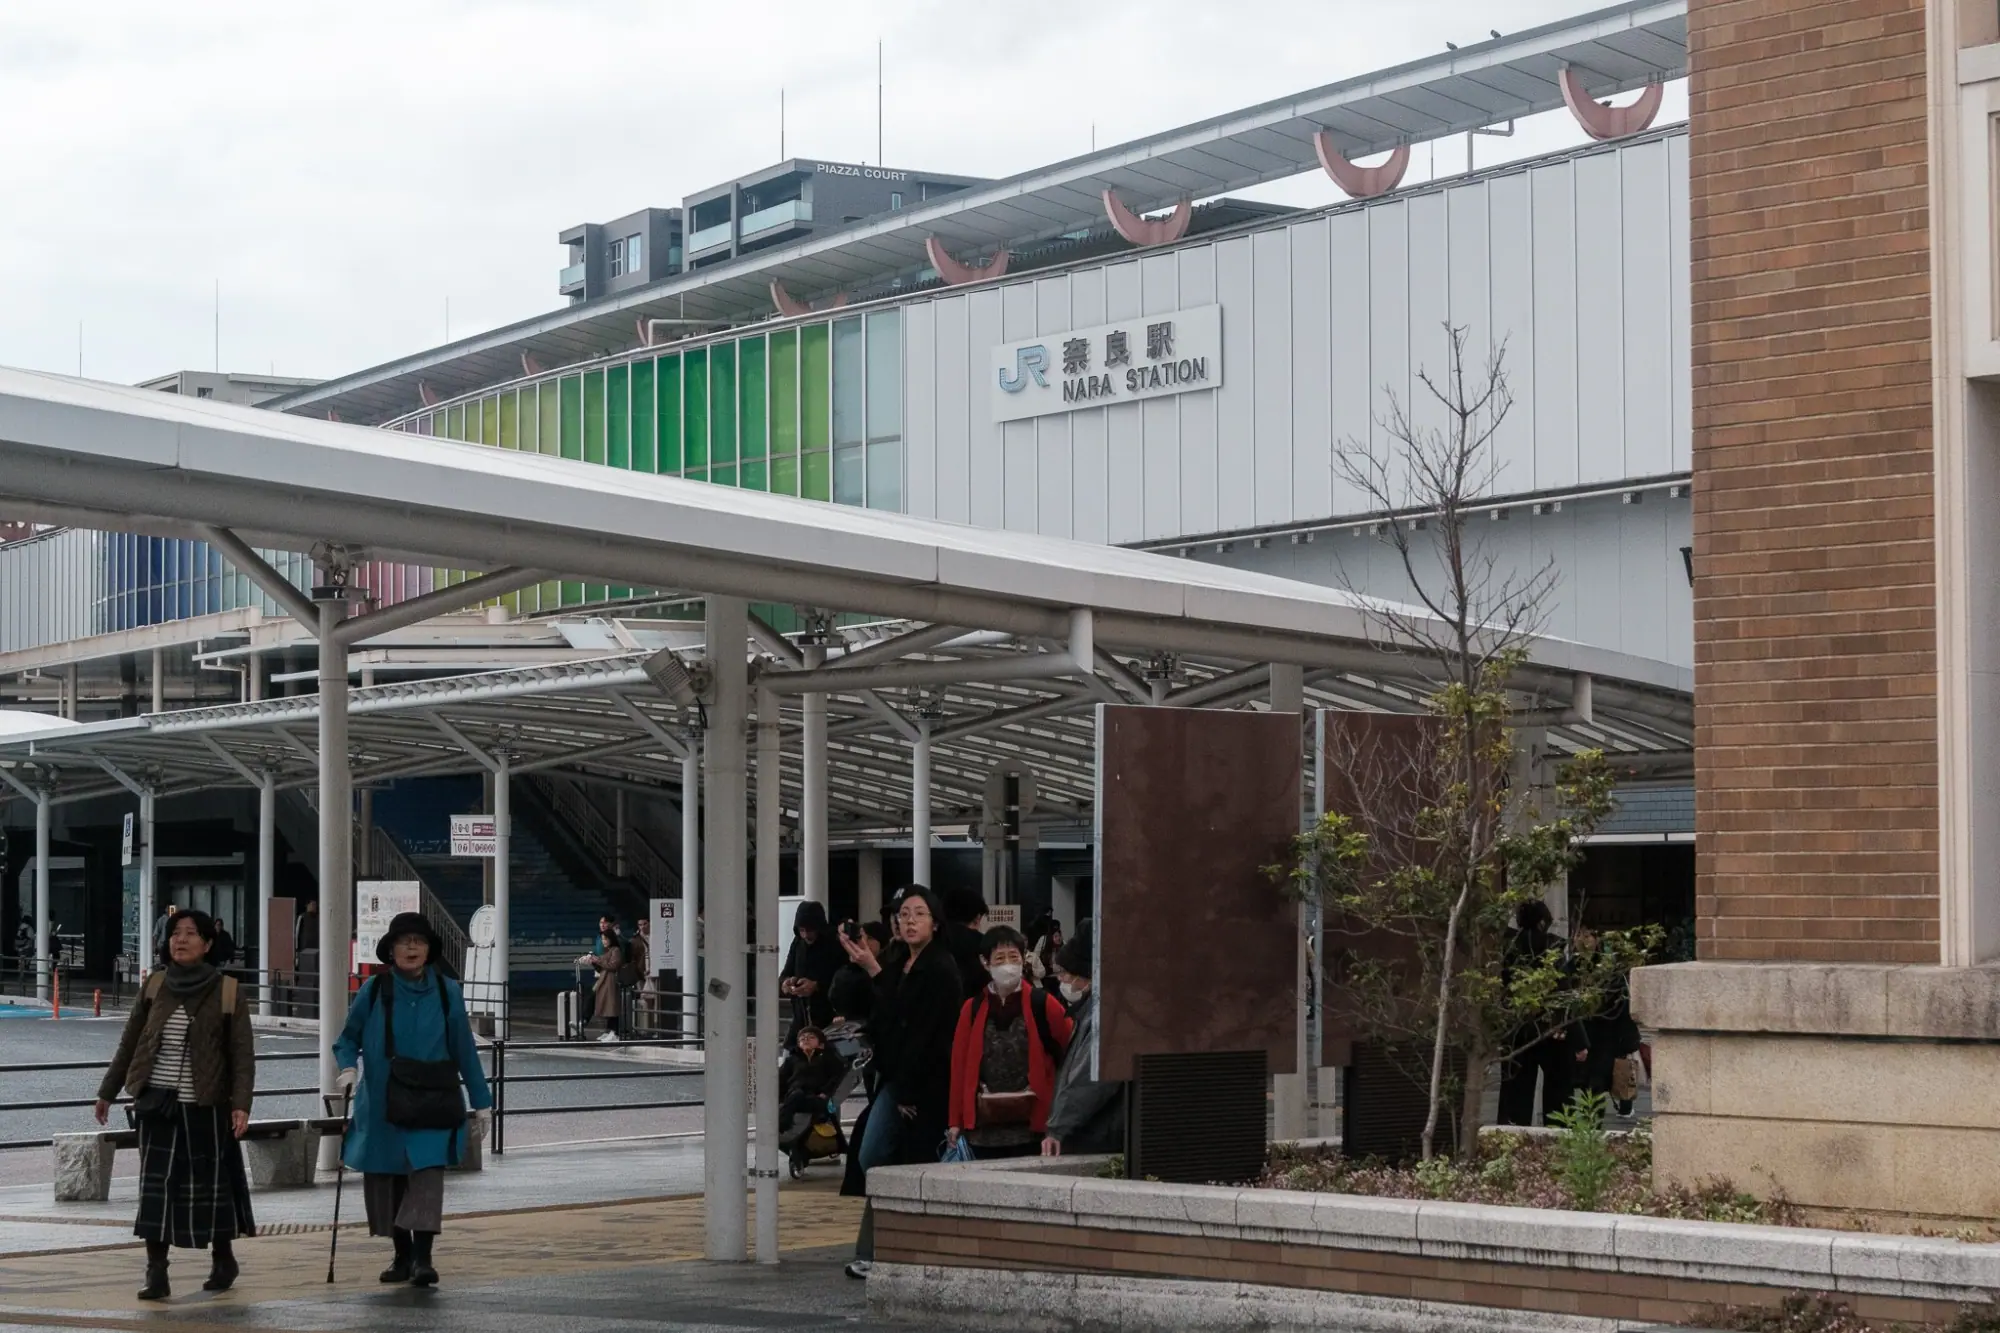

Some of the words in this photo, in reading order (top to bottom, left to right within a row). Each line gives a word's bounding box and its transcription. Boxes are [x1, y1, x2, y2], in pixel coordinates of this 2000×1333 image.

[817, 163, 860, 176] PIAZZA
[864, 168, 908, 181] COURT
[999, 344, 1050, 393] JR
[1062, 321, 1175, 374] 奈良駅
[1063, 373, 1113, 403] NARA
[1126, 356, 1207, 391] STATION
